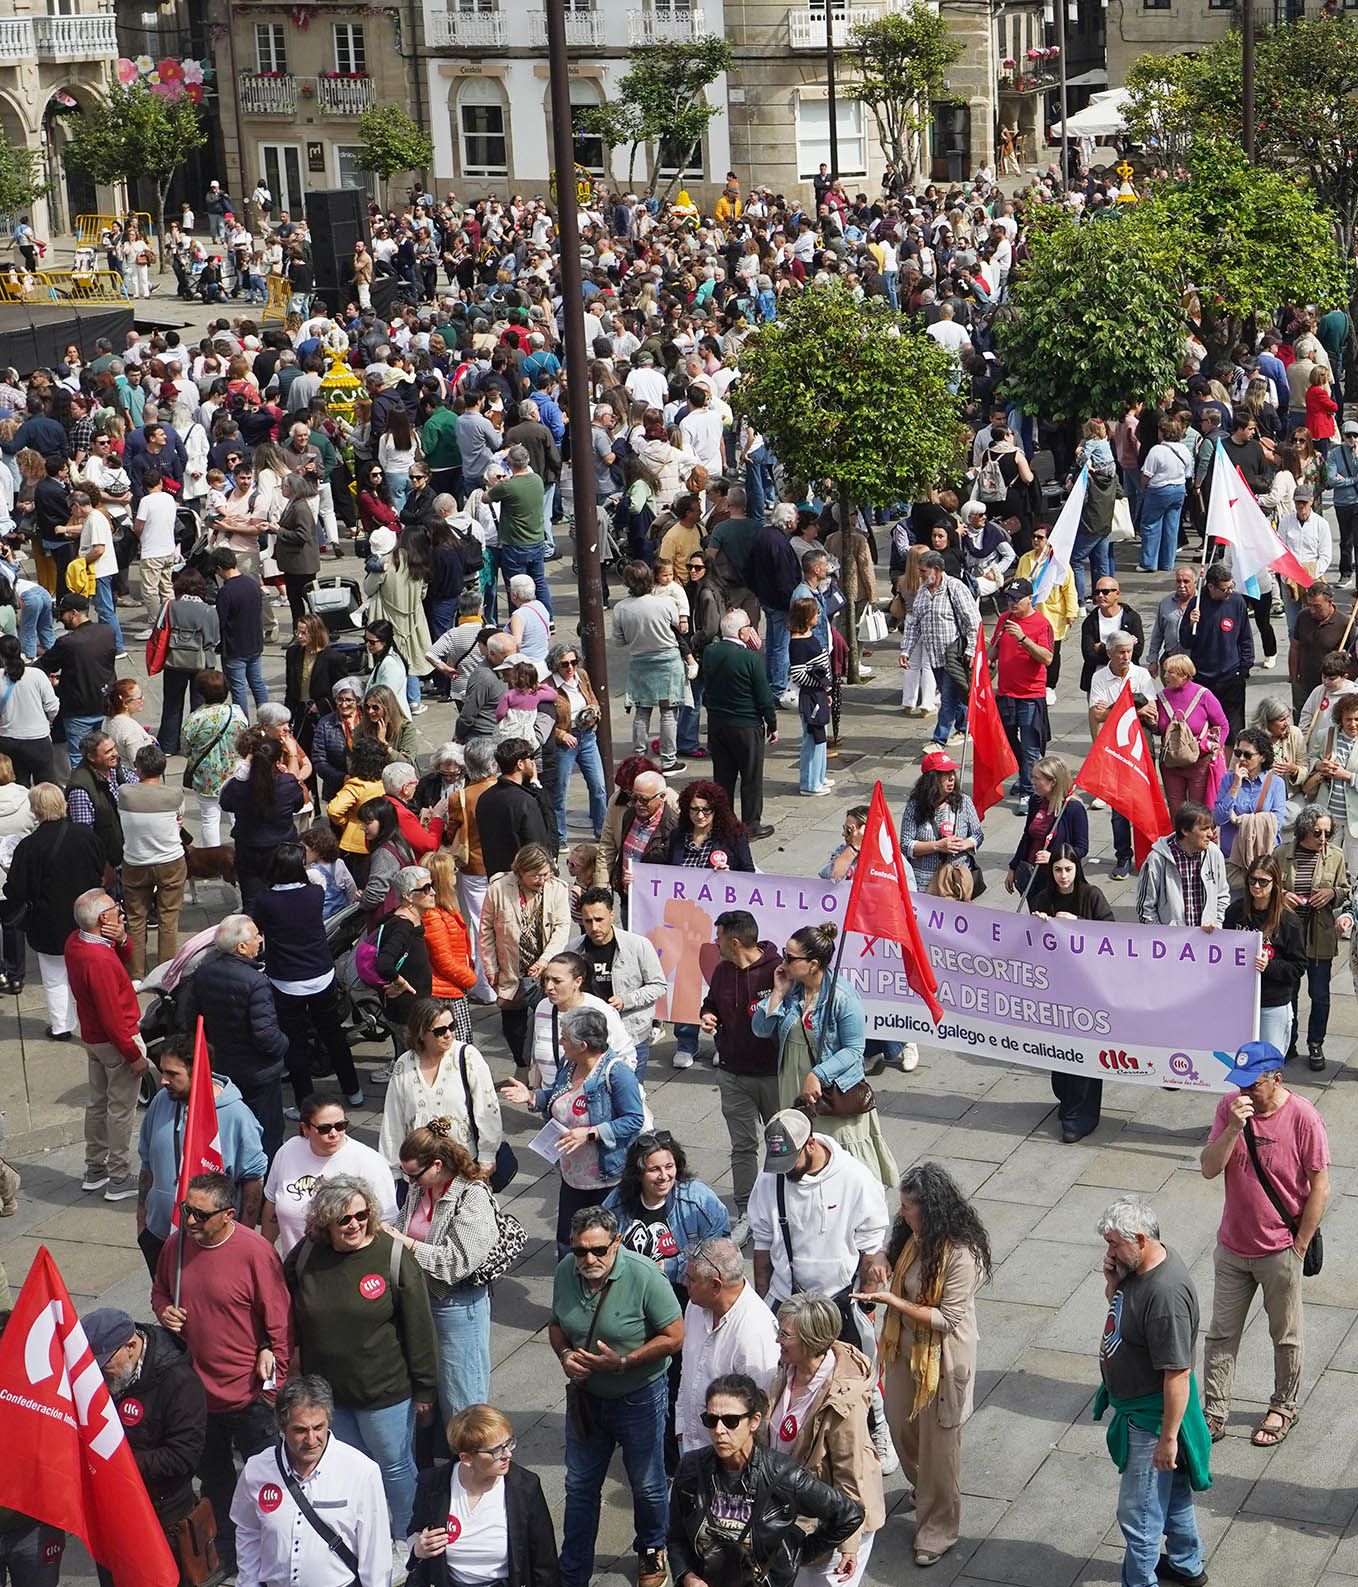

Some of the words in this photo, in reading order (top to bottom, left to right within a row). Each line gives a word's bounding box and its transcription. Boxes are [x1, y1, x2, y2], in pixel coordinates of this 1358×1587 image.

[650, 879, 838, 912] TRABALLO
[992, 923, 1001, 942] E
[1025, 930, 1246, 966] IGUALDADE
[929, 944, 1050, 992] RECORTES
[960, 985, 989, 1013] DE
[994, 991, 1112, 1035] DEREITOS
[874, 1013, 934, 1035] público,
[937, 1023, 985, 1046] galego
[988, 1036, 998, 1046] e
[1001, 1035, 1019, 1050] de
[1022, 1041, 1084, 1063] calidade
[1099, 1049, 1139, 1069] CIG
[363, 1279, 380, 1290] CIG
[0, 1387, 66, 1420] Confederación
[123, 1402, 139, 1416] CIG
[263, 1489, 278, 1501] CIG
